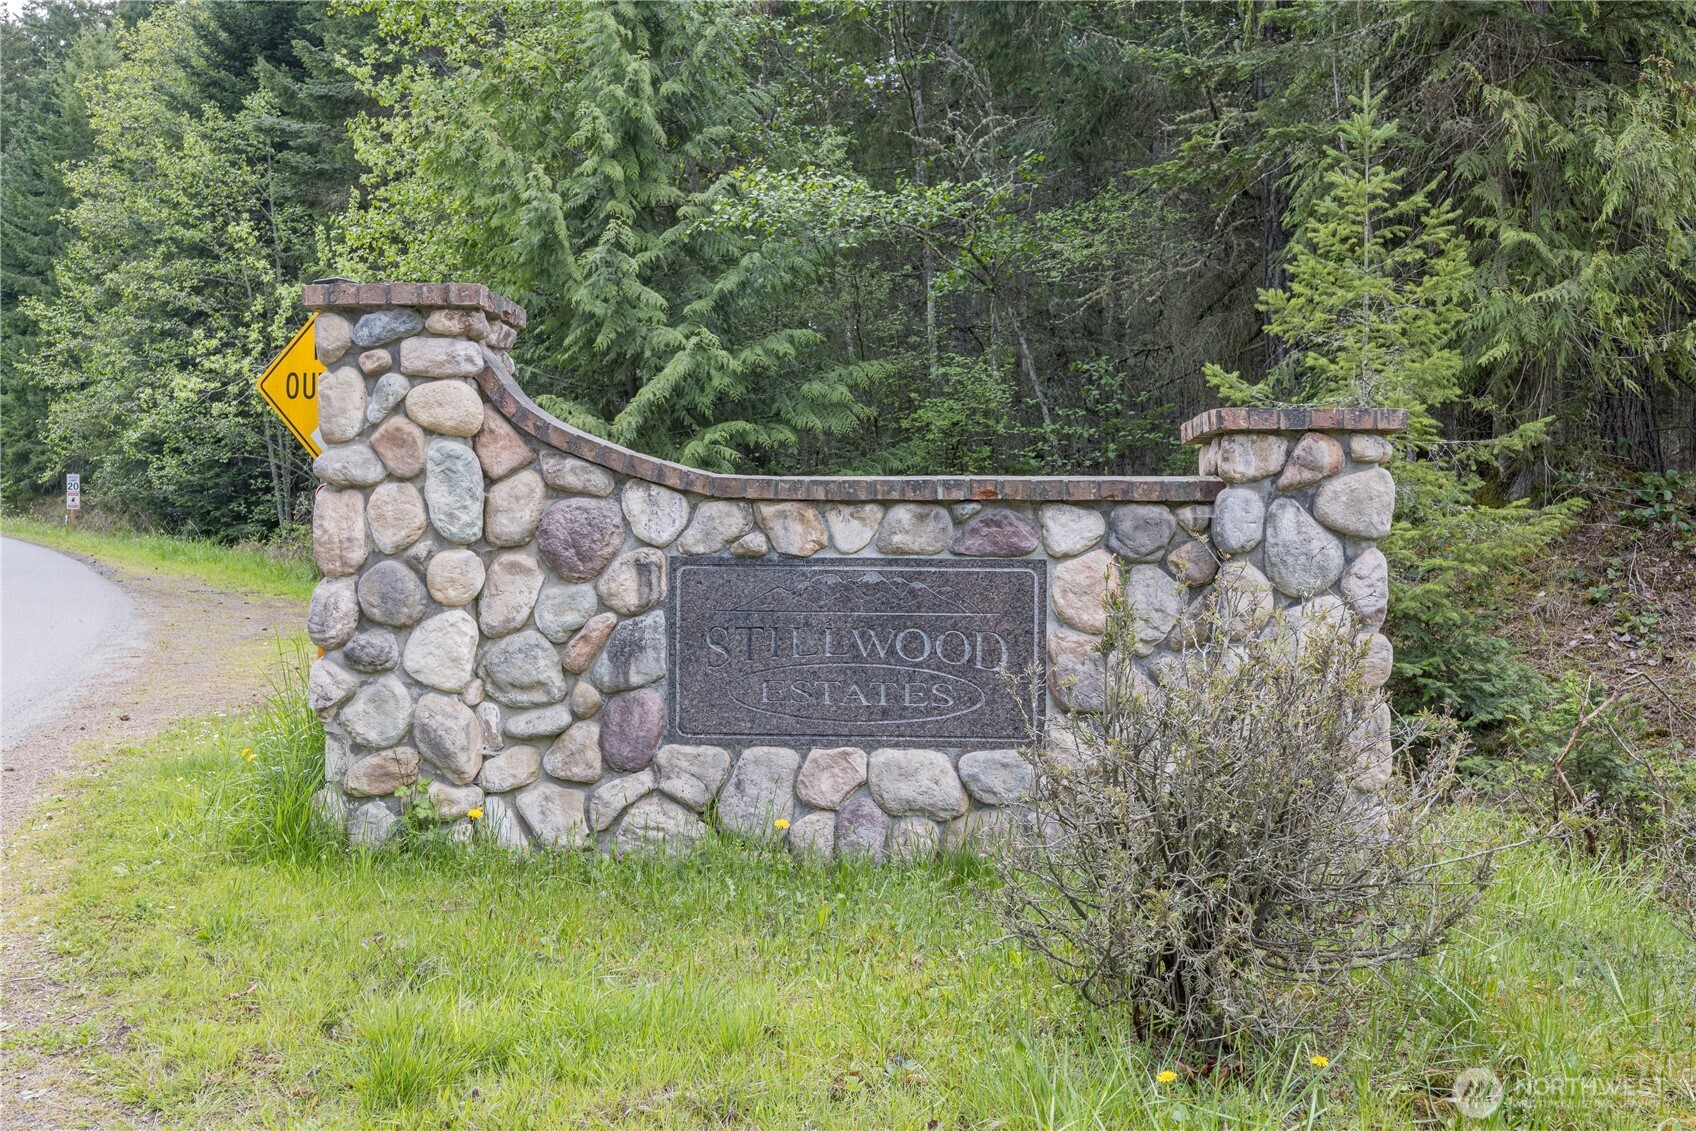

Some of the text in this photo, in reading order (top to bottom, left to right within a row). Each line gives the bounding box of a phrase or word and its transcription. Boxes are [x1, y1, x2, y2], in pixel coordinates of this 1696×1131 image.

[286, 372, 323, 399] OU
[68, 482, 79, 490] 20
[706, 626, 1008, 671] STILLWOOD
[761, 679, 954, 707] ESTATES
